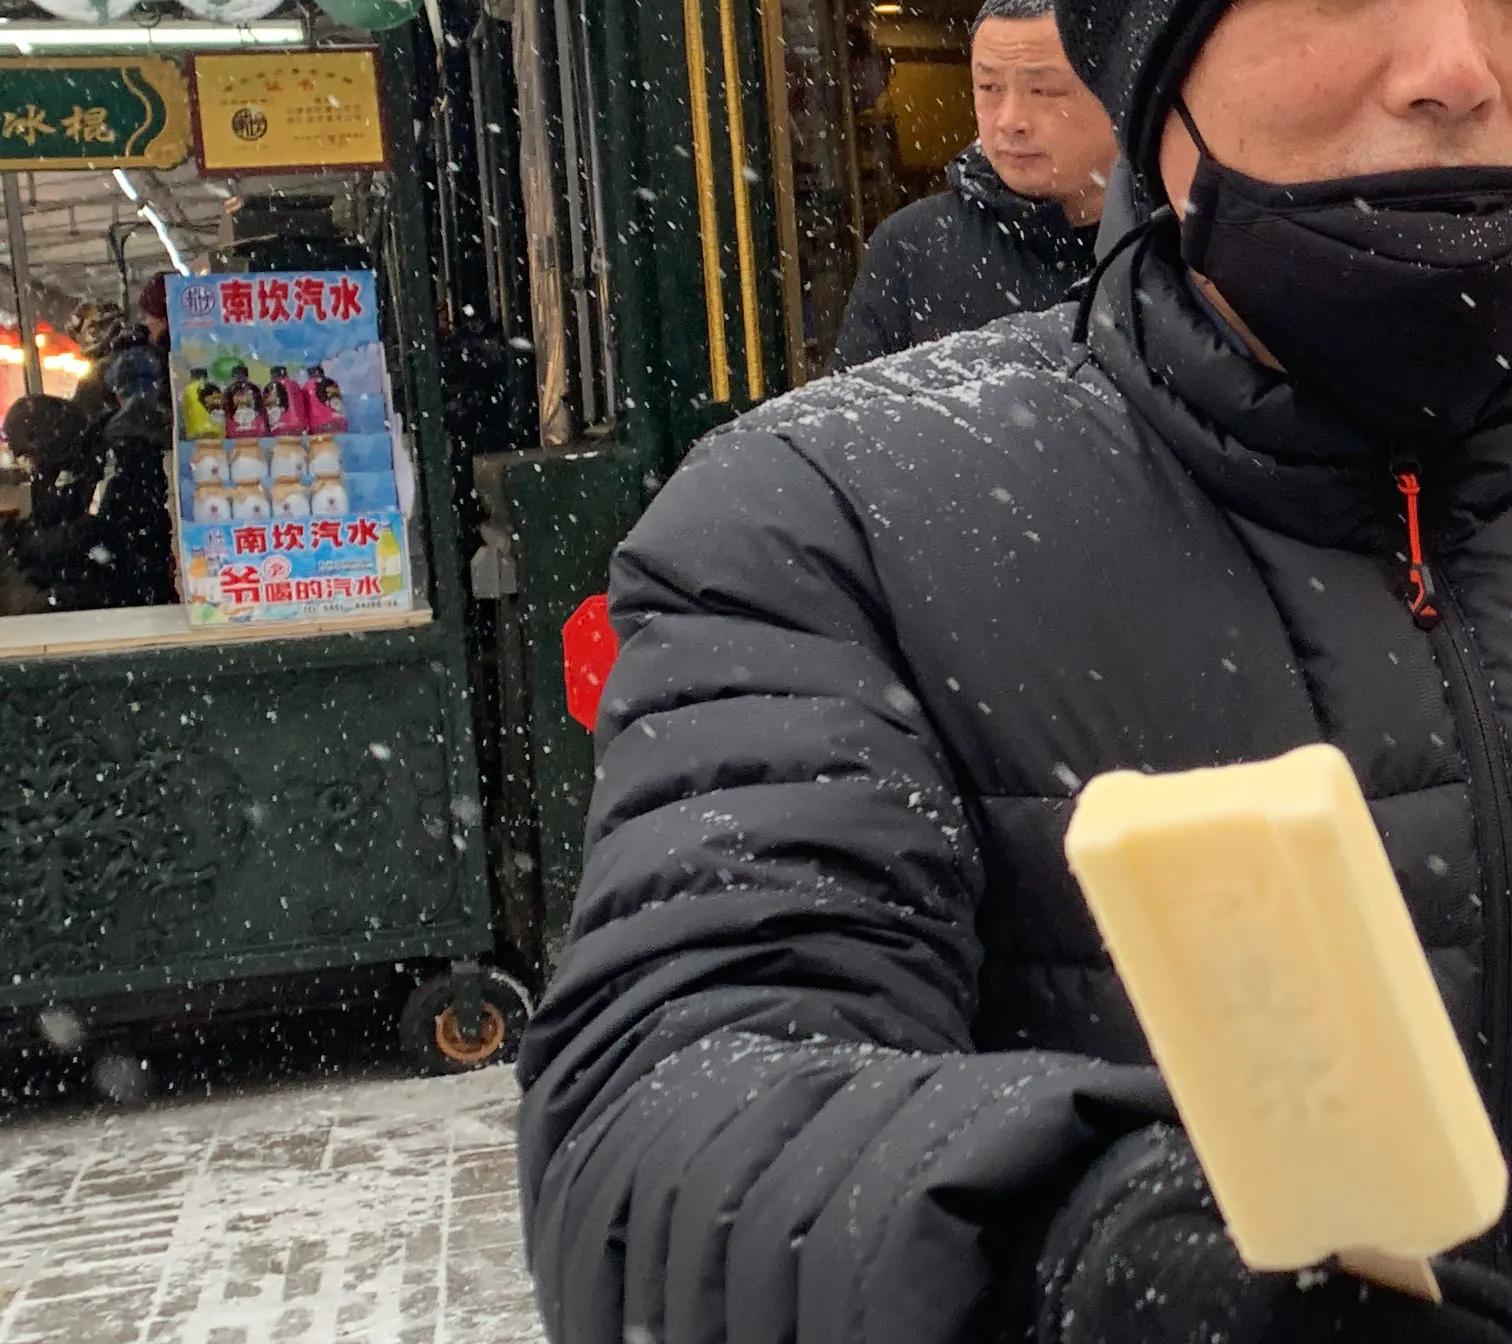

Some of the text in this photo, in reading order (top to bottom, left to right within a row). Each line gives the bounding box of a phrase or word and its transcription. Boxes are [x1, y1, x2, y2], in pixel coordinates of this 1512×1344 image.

[2, 104, 116, 146] 冰棍
[220, 275, 363, 324] 南坎汽水
[232, 517, 381, 555] 南坎汽水
